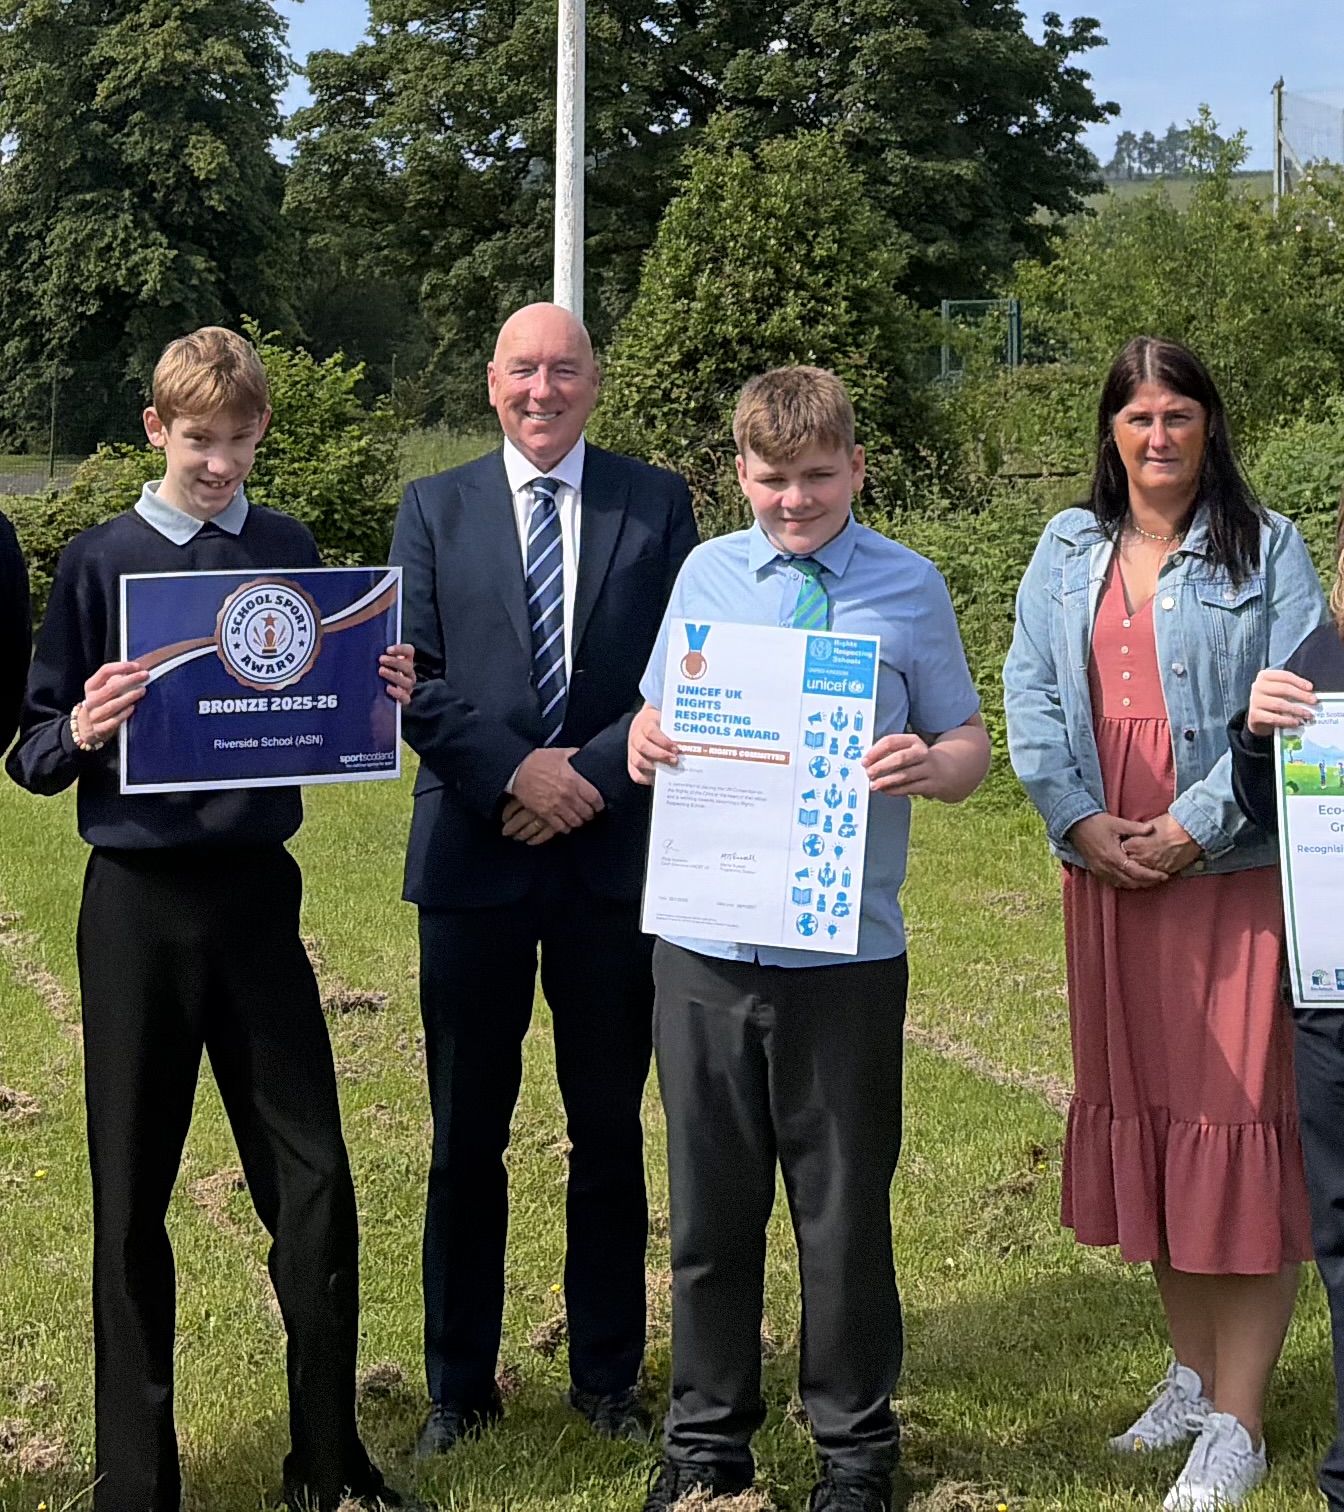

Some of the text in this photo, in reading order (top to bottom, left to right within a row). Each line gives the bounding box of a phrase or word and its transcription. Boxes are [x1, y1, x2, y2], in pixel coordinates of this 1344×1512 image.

[231, 594, 307, 635] SCHOOL SPORT
[241, 653, 296, 674] AWARD
[677, 684, 743, 699] UNICEF UK
[807, 677, 848, 692] unicef
[199, 695, 338, 714] BRONZE 2025-26
[676, 698, 722, 710] RIGHTS
[675, 710, 752, 725] RESPECTING
[673, 723, 780, 741] SCHOOLS AWARD
[214, 735, 324, 749] Riverside School (ASN)
[709, 748, 738, 757] RIGHTS
[739, 751, 786, 761] COMMITTED
